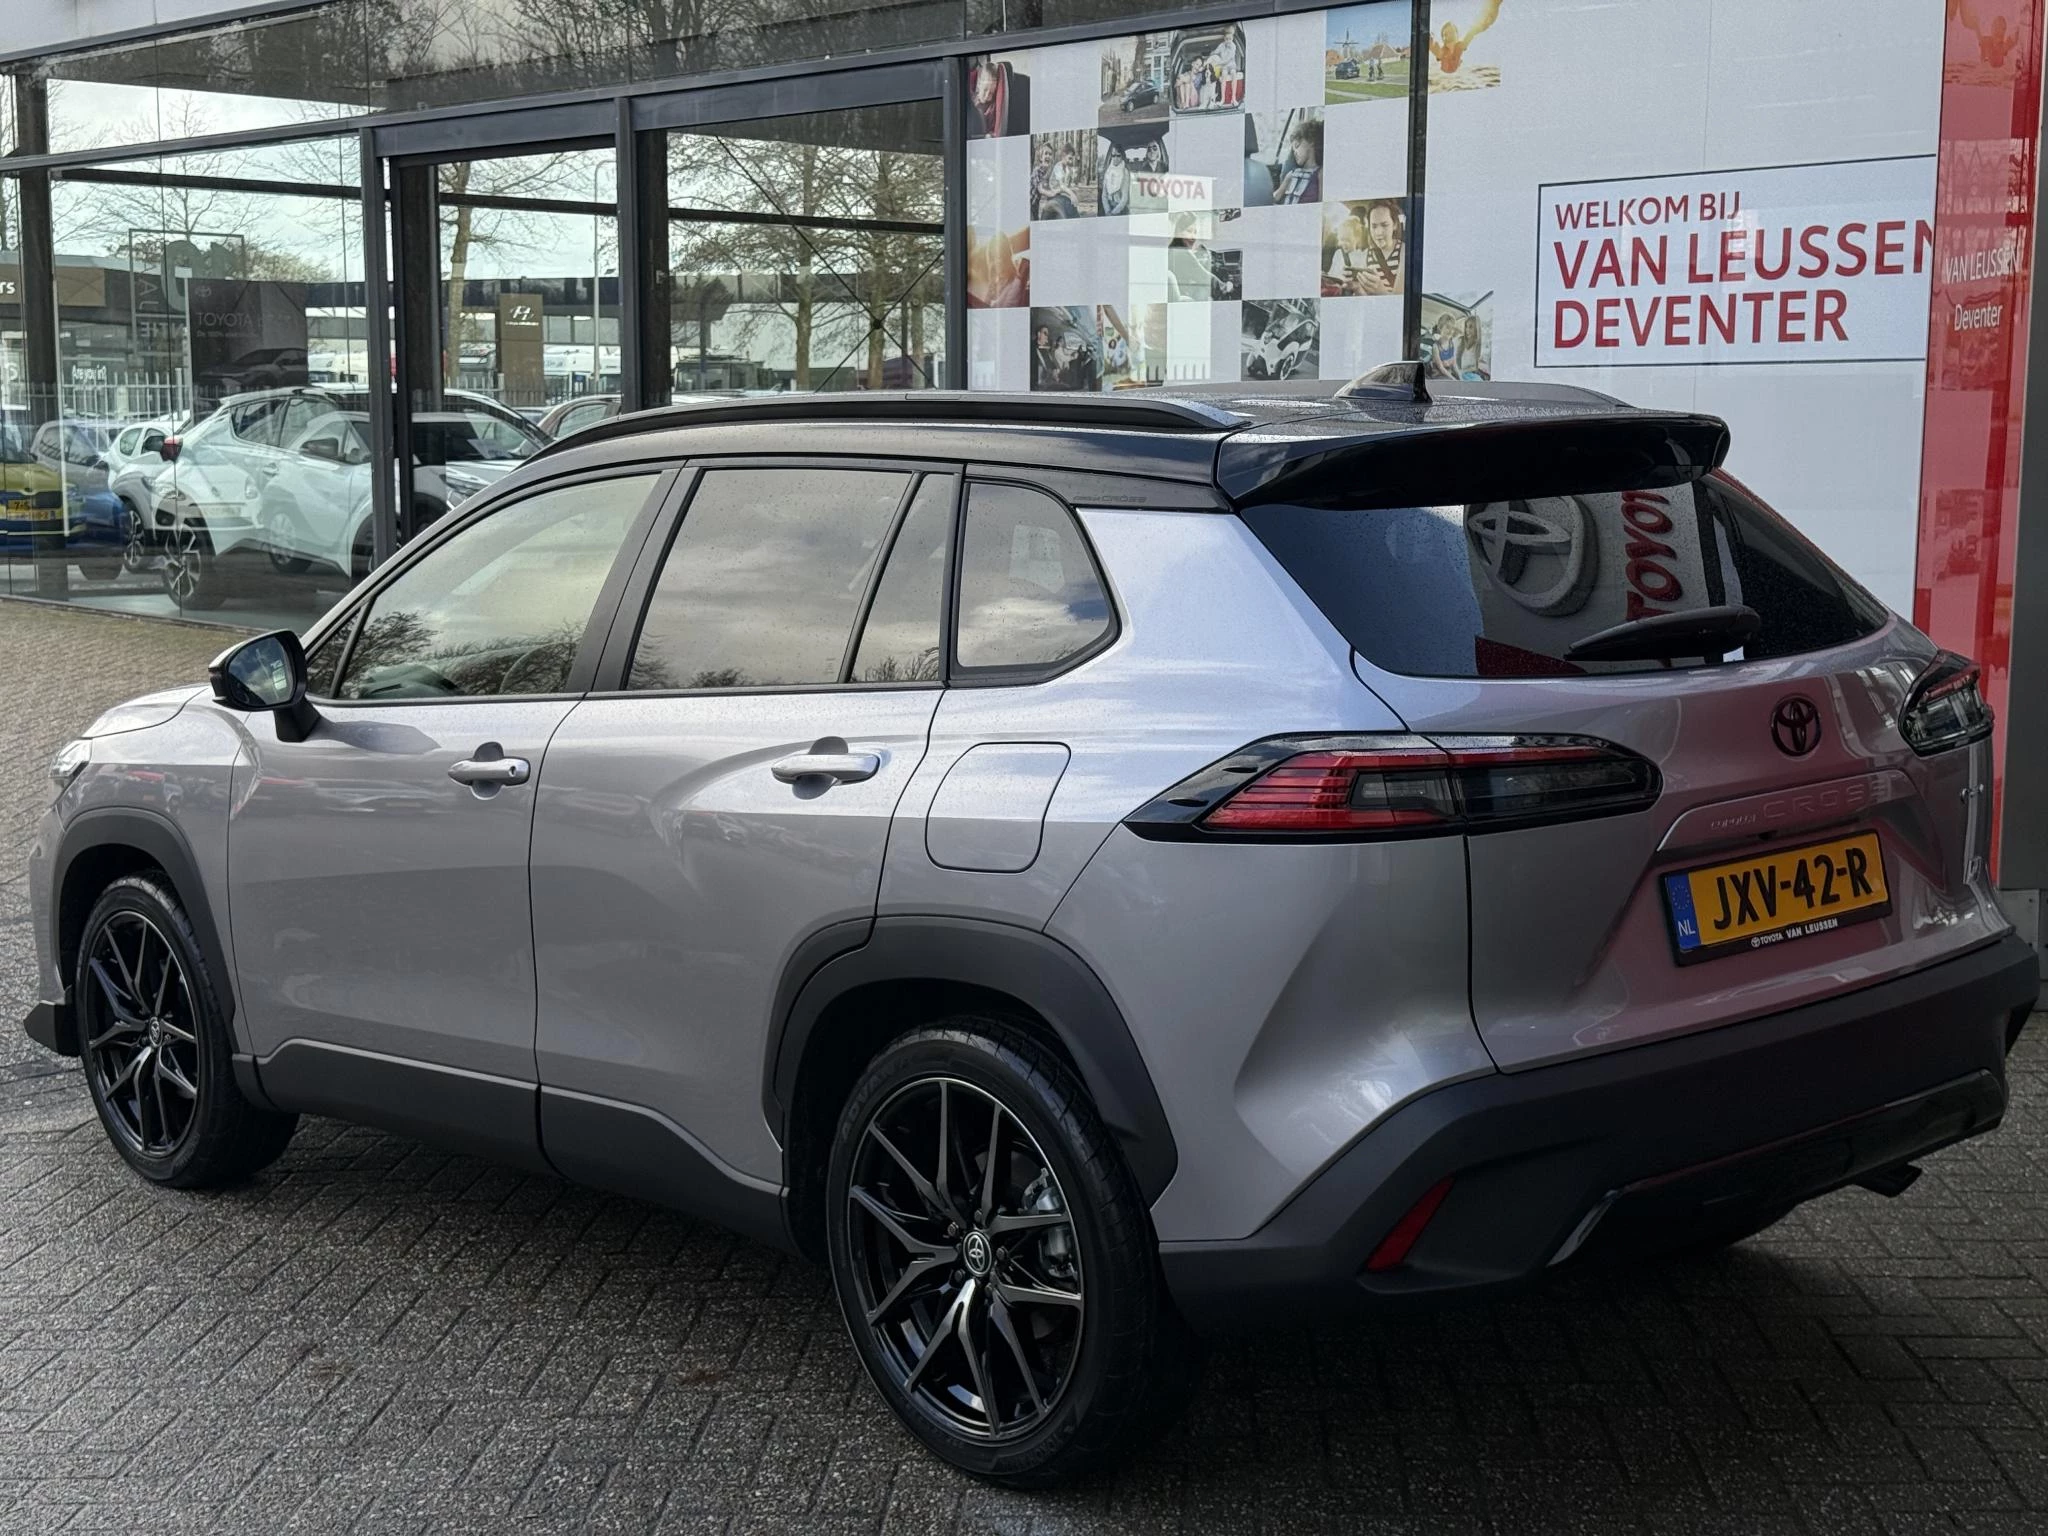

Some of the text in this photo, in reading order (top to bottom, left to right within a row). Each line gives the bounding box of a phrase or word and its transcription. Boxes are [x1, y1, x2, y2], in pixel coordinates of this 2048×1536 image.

[1136, 178, 1205, 199] TOYOTA
[1554, 191, 1741, 230] WELKOM BIJ
[1552, 235, 1668, 290] VAN
[1945, 245, 2022, 284] VAN LEUSSEN
[196, 312, 252, 327] TOYOTA
[1553, 289, 1849, 349] DEVENTER
[1954, 301, 2003, 331] Deventer
[1713, 848, 1873, 930] JXV-42-R
[1678, 919, 1696, 937] NL
[1760, 917, 1839, 945] TOYOTA VAN LEUSSEN
